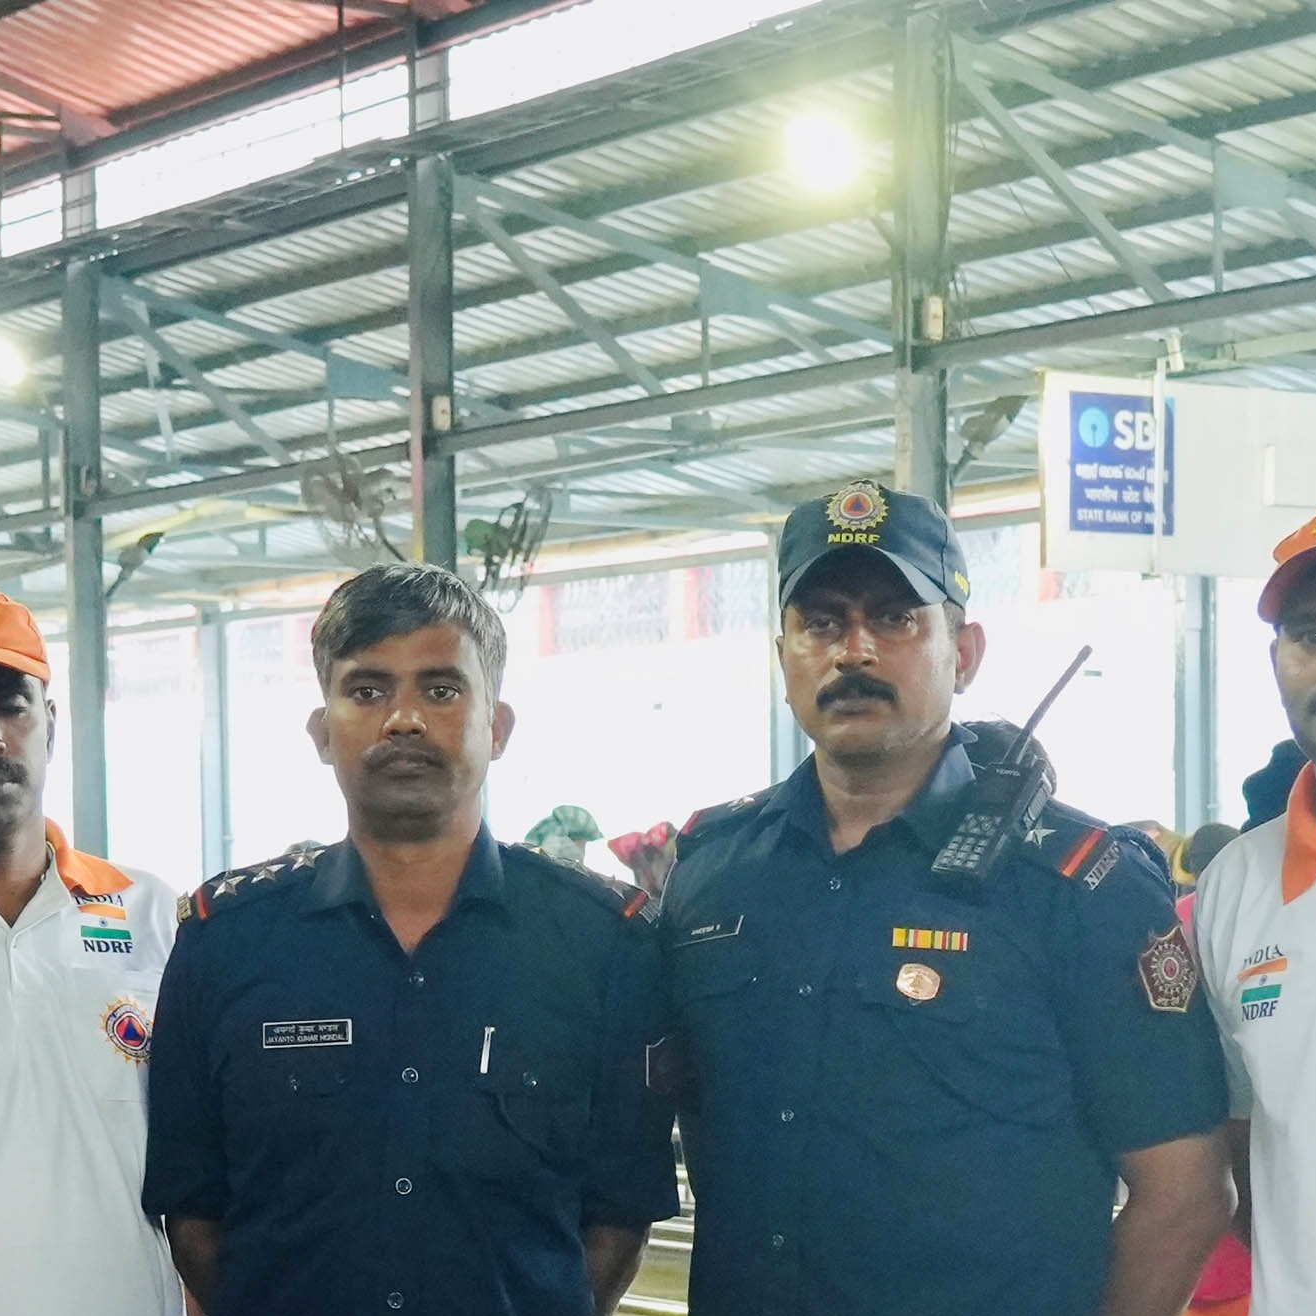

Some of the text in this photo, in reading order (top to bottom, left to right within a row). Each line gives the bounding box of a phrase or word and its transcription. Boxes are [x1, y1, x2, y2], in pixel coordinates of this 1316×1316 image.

[1114, 409, 1156, 450] SB
[827, 533, 880, 544] NDRF
[83, 939, 133, 954] NDRF
[1242, 1000, 1278, 1022] NDRF
